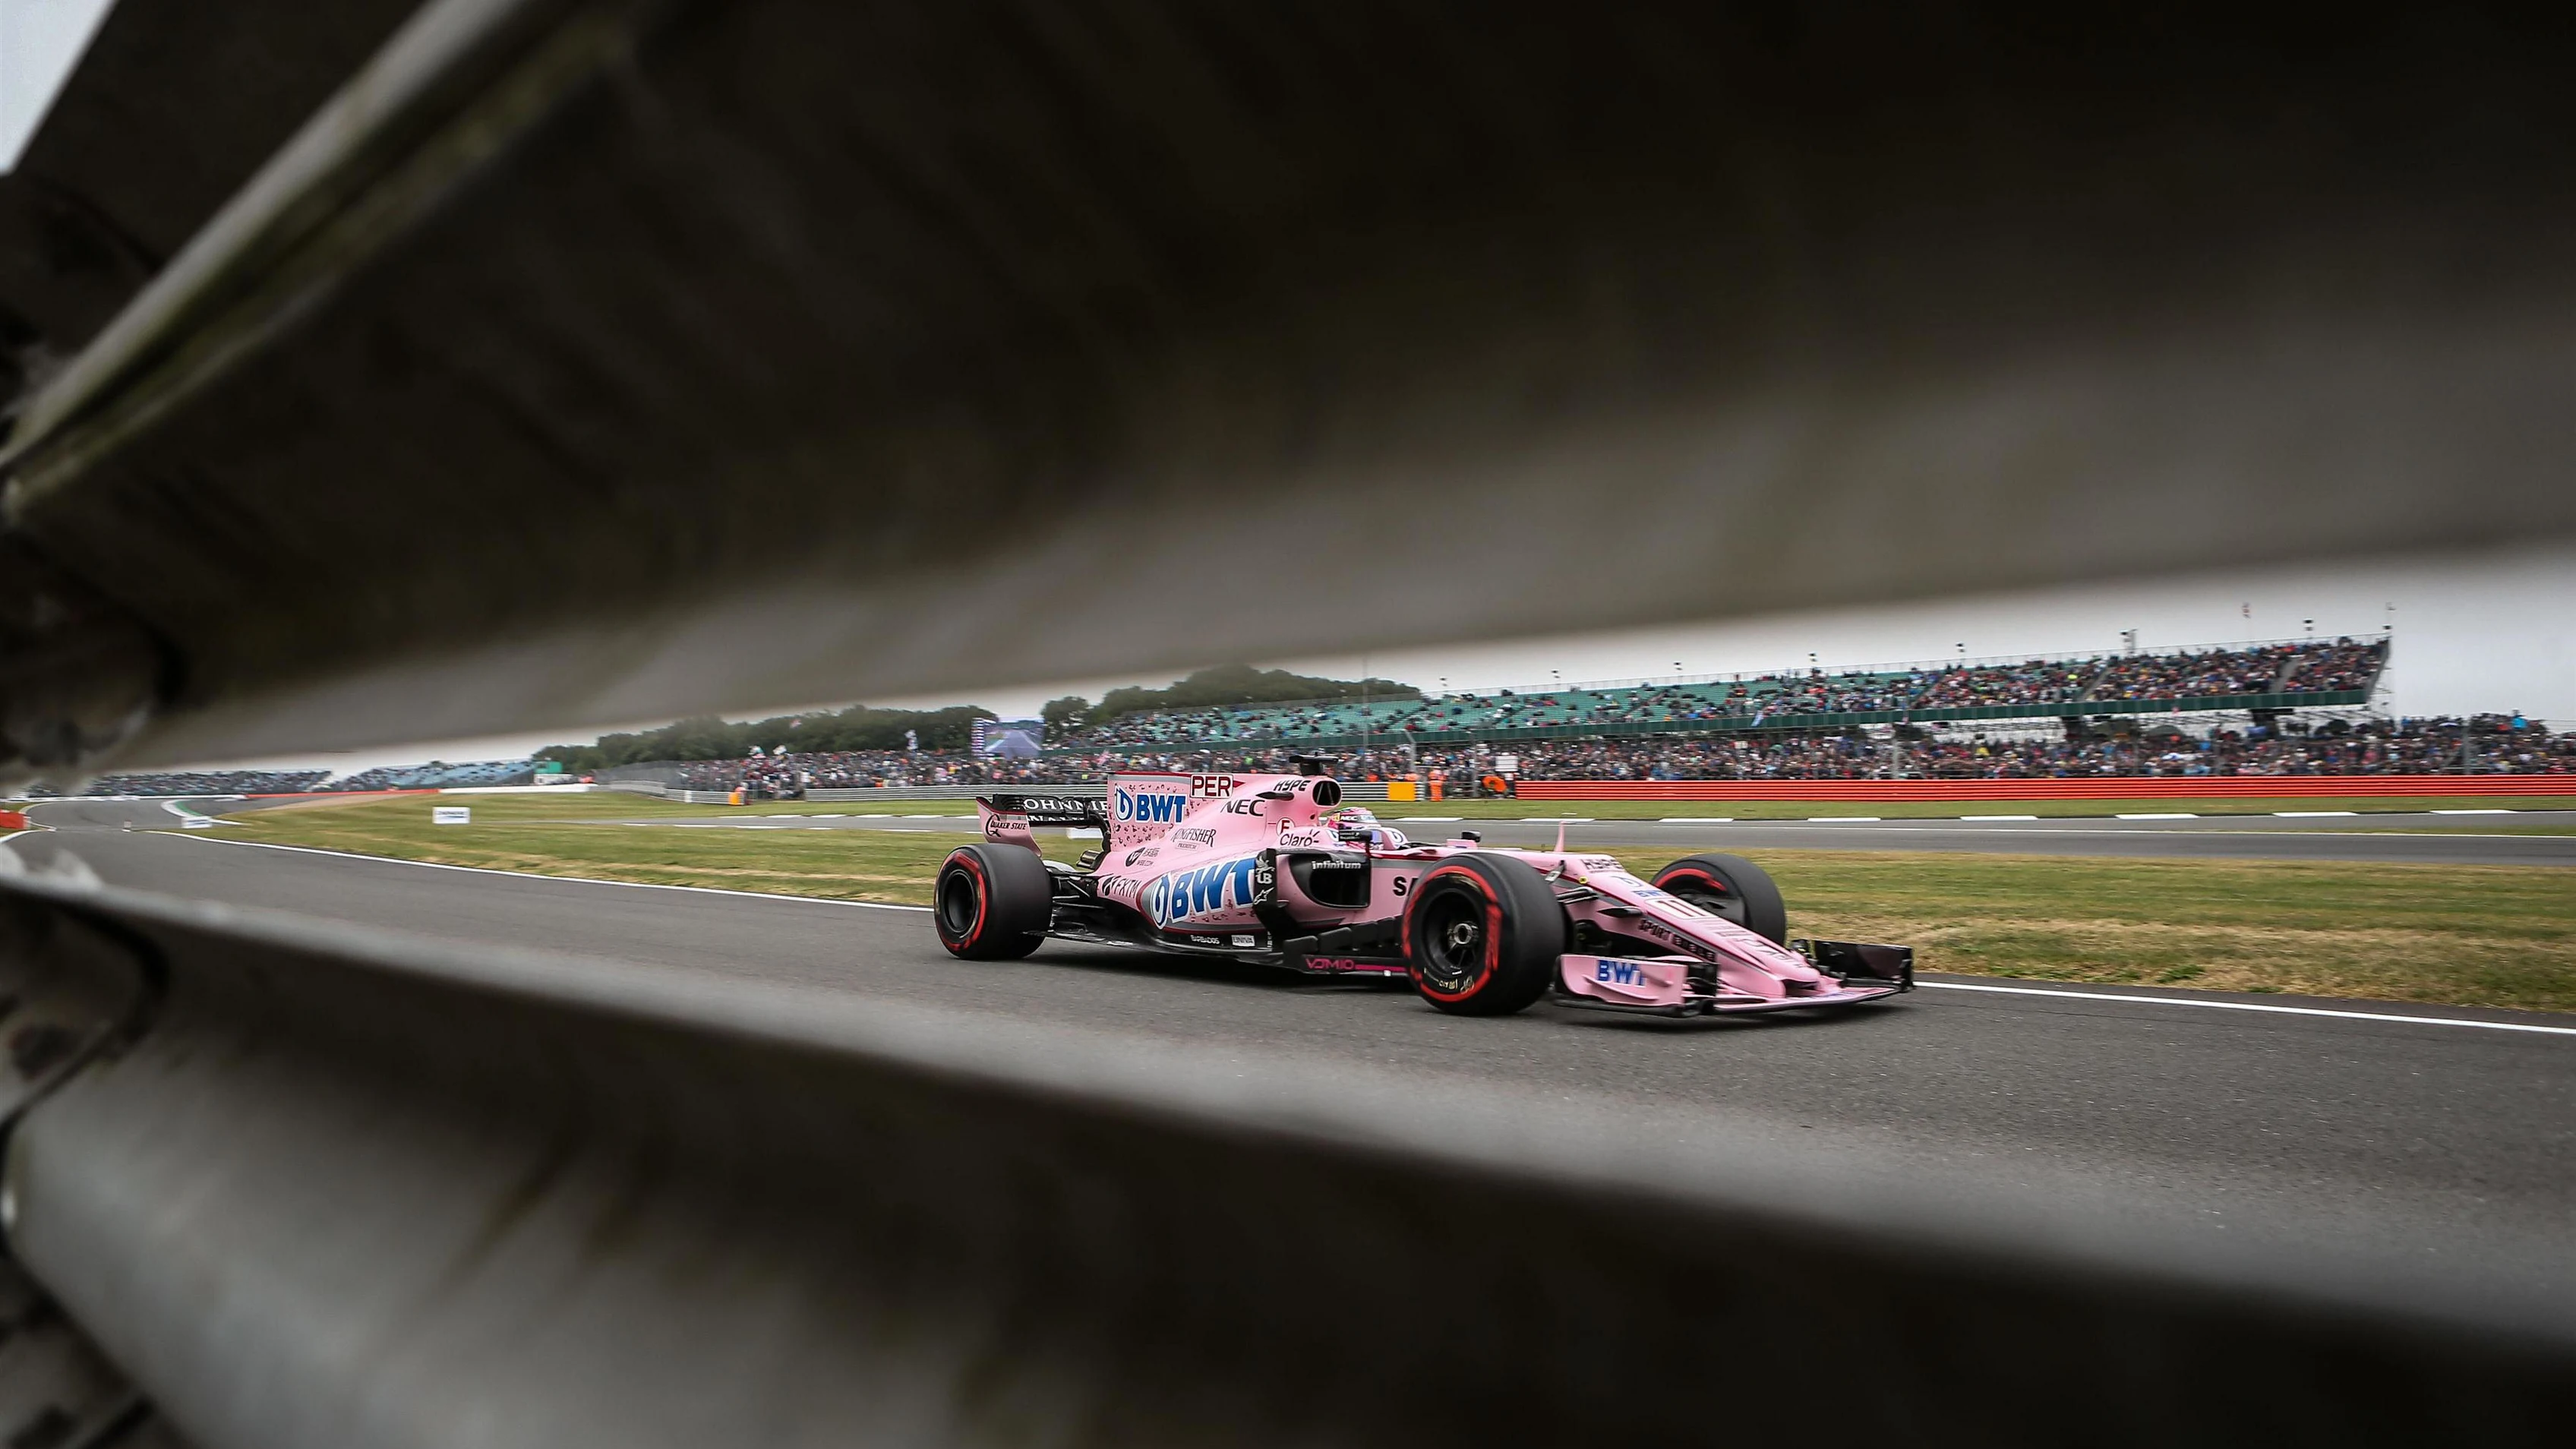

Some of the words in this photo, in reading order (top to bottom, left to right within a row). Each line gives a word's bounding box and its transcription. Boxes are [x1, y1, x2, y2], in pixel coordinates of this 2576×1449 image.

[1192, 775, 1231, 797] PER
[1274, 780, 1312, 791] HYPE
[1023, 798, 1107, 810] OHNNIE
[1136, 794, 1187, 823] BWT
[1220, 799, 1265, 816] NEC
[1170, 828, 1217, 848] KINGFISHER
[1280, 833, 1314, 847] Claro
[1312, 860, 1362, 870] infinitum
[1114, 878, 1142, 898] FXTM
[1172, 857, 1257, 920] BWT
